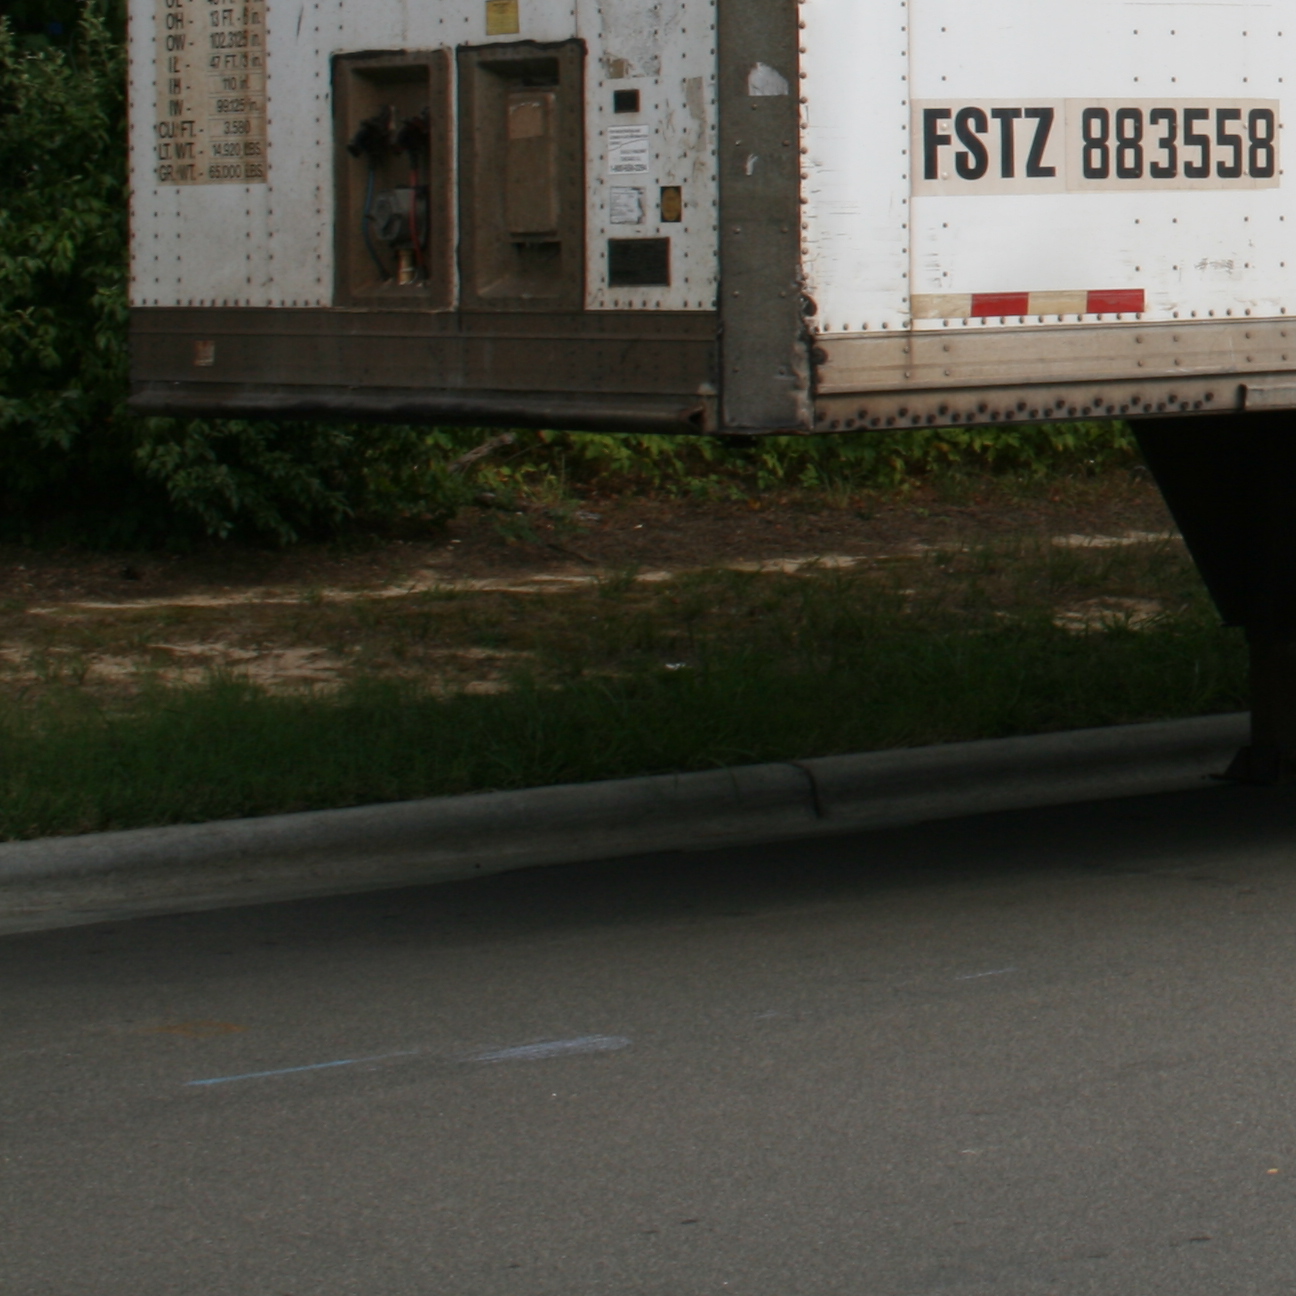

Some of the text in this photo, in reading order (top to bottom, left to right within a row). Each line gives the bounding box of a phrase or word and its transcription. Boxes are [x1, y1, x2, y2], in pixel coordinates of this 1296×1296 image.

[165, 11, 184, 30] OH
[165, 33, 186, 52] OW
[923, 106, 1275, 180] FSTZ 883558
